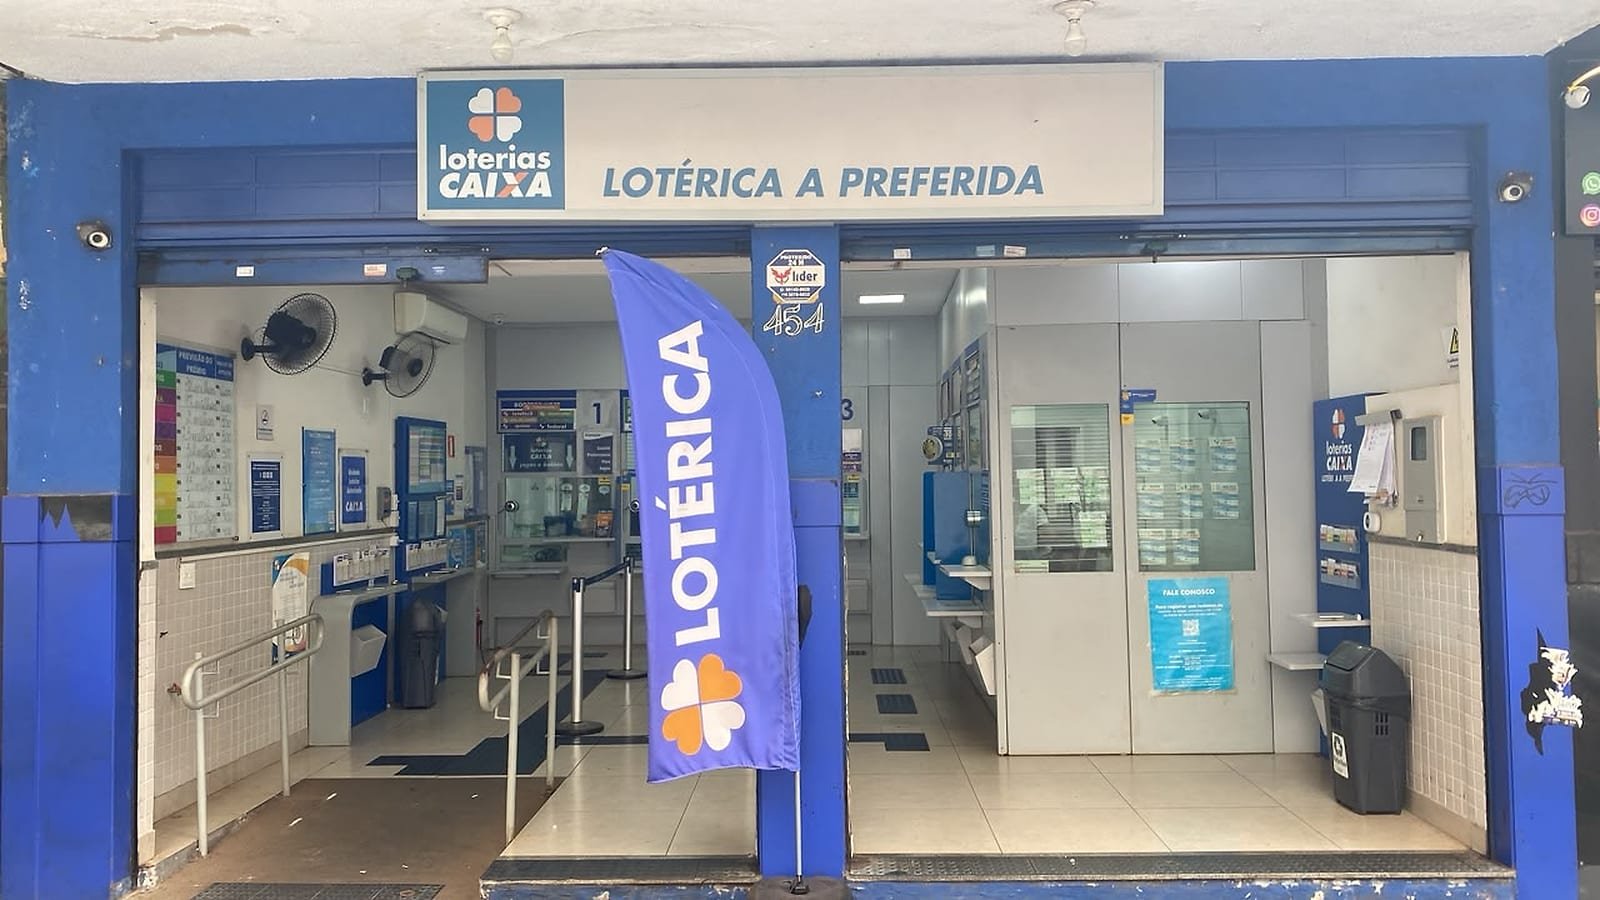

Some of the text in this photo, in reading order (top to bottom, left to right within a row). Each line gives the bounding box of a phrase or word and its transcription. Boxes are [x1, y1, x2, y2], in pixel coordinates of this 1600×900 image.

[439, 144, 552, 171] loterias
[439, 172, 552, 199] CAIXA
[603, 157, 1045, 199] LOTÉRICA A PREFERIDA
[763, 302, 825, 336] 454
[592, 402, 601, 425] 1
[841, 398, 854, 421] 3
[1326, 440, 1352, 456] loterias
[1326, 455, 1353, 471] CAIXA
[655, 319, 721, 647] LOTÉRICA
[1162, 588, 1216, 597] FALE CONOSCO
